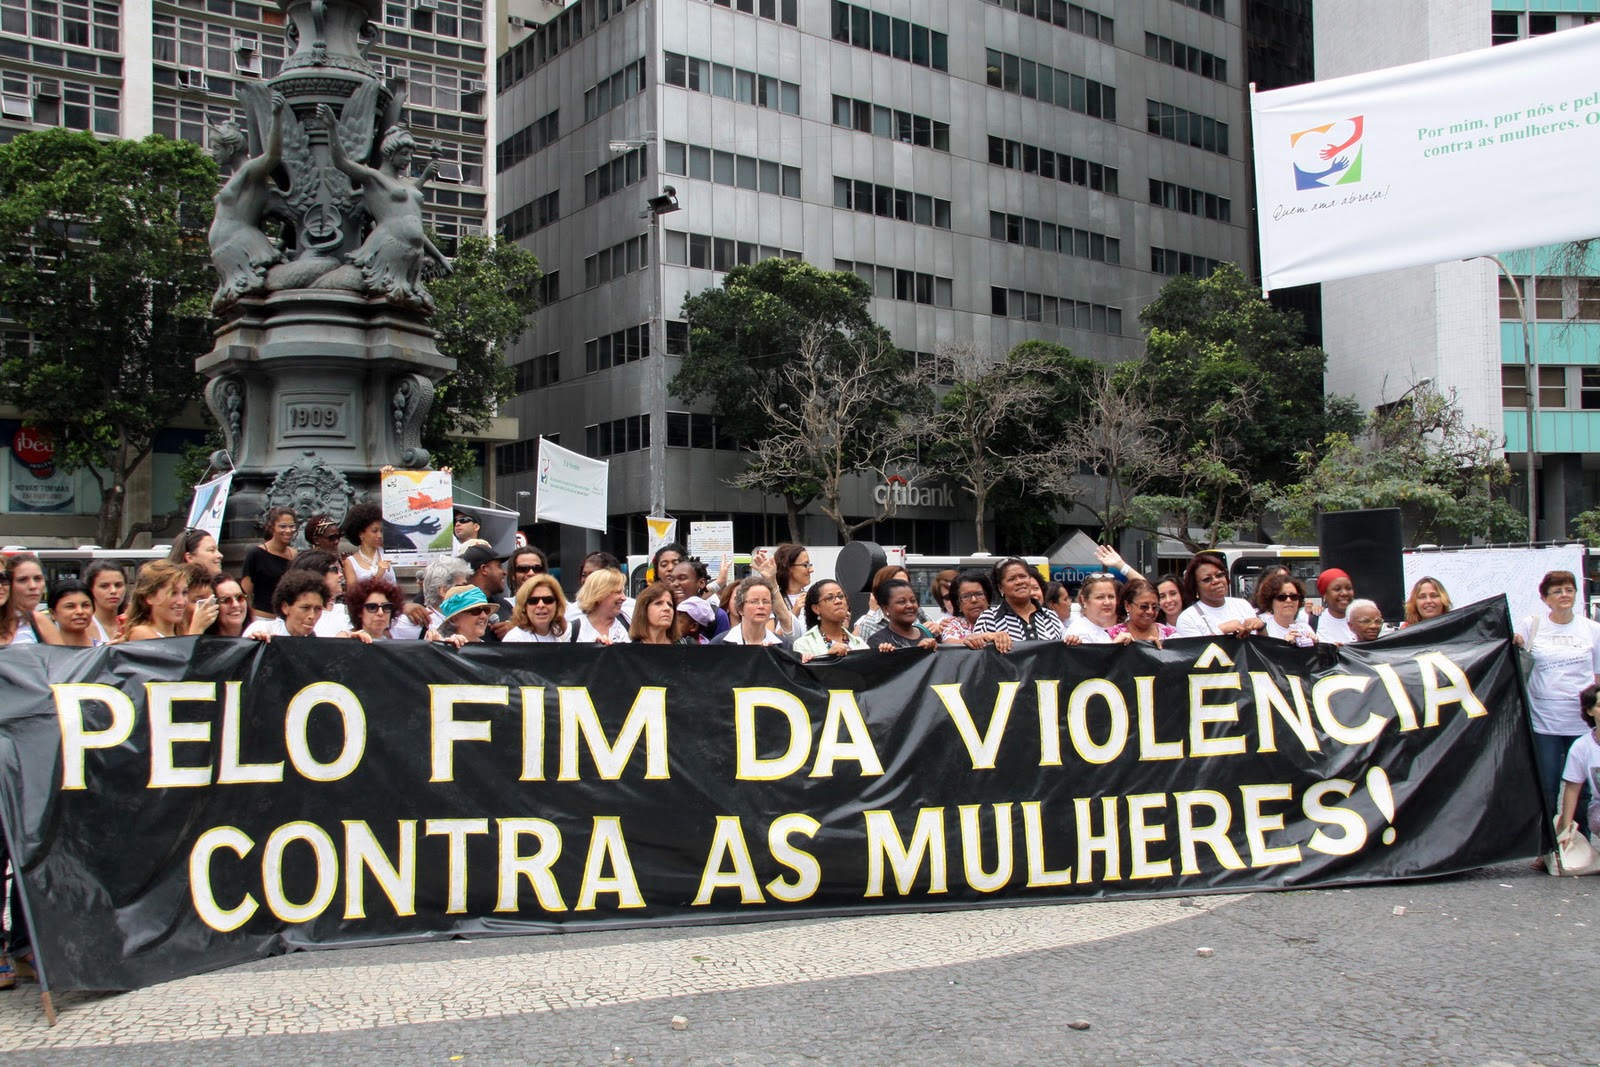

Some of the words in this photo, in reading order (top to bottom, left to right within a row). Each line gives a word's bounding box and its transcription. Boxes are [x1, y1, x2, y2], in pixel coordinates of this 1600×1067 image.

[1417, 127, 1444, 141] Por
[1449, 119, 1489, 135] mim,
[1493, 110, 1522, 129] por
[1527, 102, 1554, 119] nós
[1559, 101, 1568, 111] e
[1423, 140, 1473, 158] contra
[1478, 135, 1494, 148] as
[1499, 118, 1579, 144] mulheres.
[1272, 204, 1308, 222] Quem
[1311, 199, 1336, 211] ama
[1340, 184, 1391, 204] abraça!
[290, 407, 338, 429] 1909
[50, 680, 367, 790] PELO
[427, 683, 671, 783] FIM
[732, 687, 885, 781] DA
[931, 643, 1488, 770] VIOLÊNCIA
[188, 815, 647, 932] CONTRA
[690, 813, 822, 906] AS
[863, 766, 1397, 898] MULHERES!
